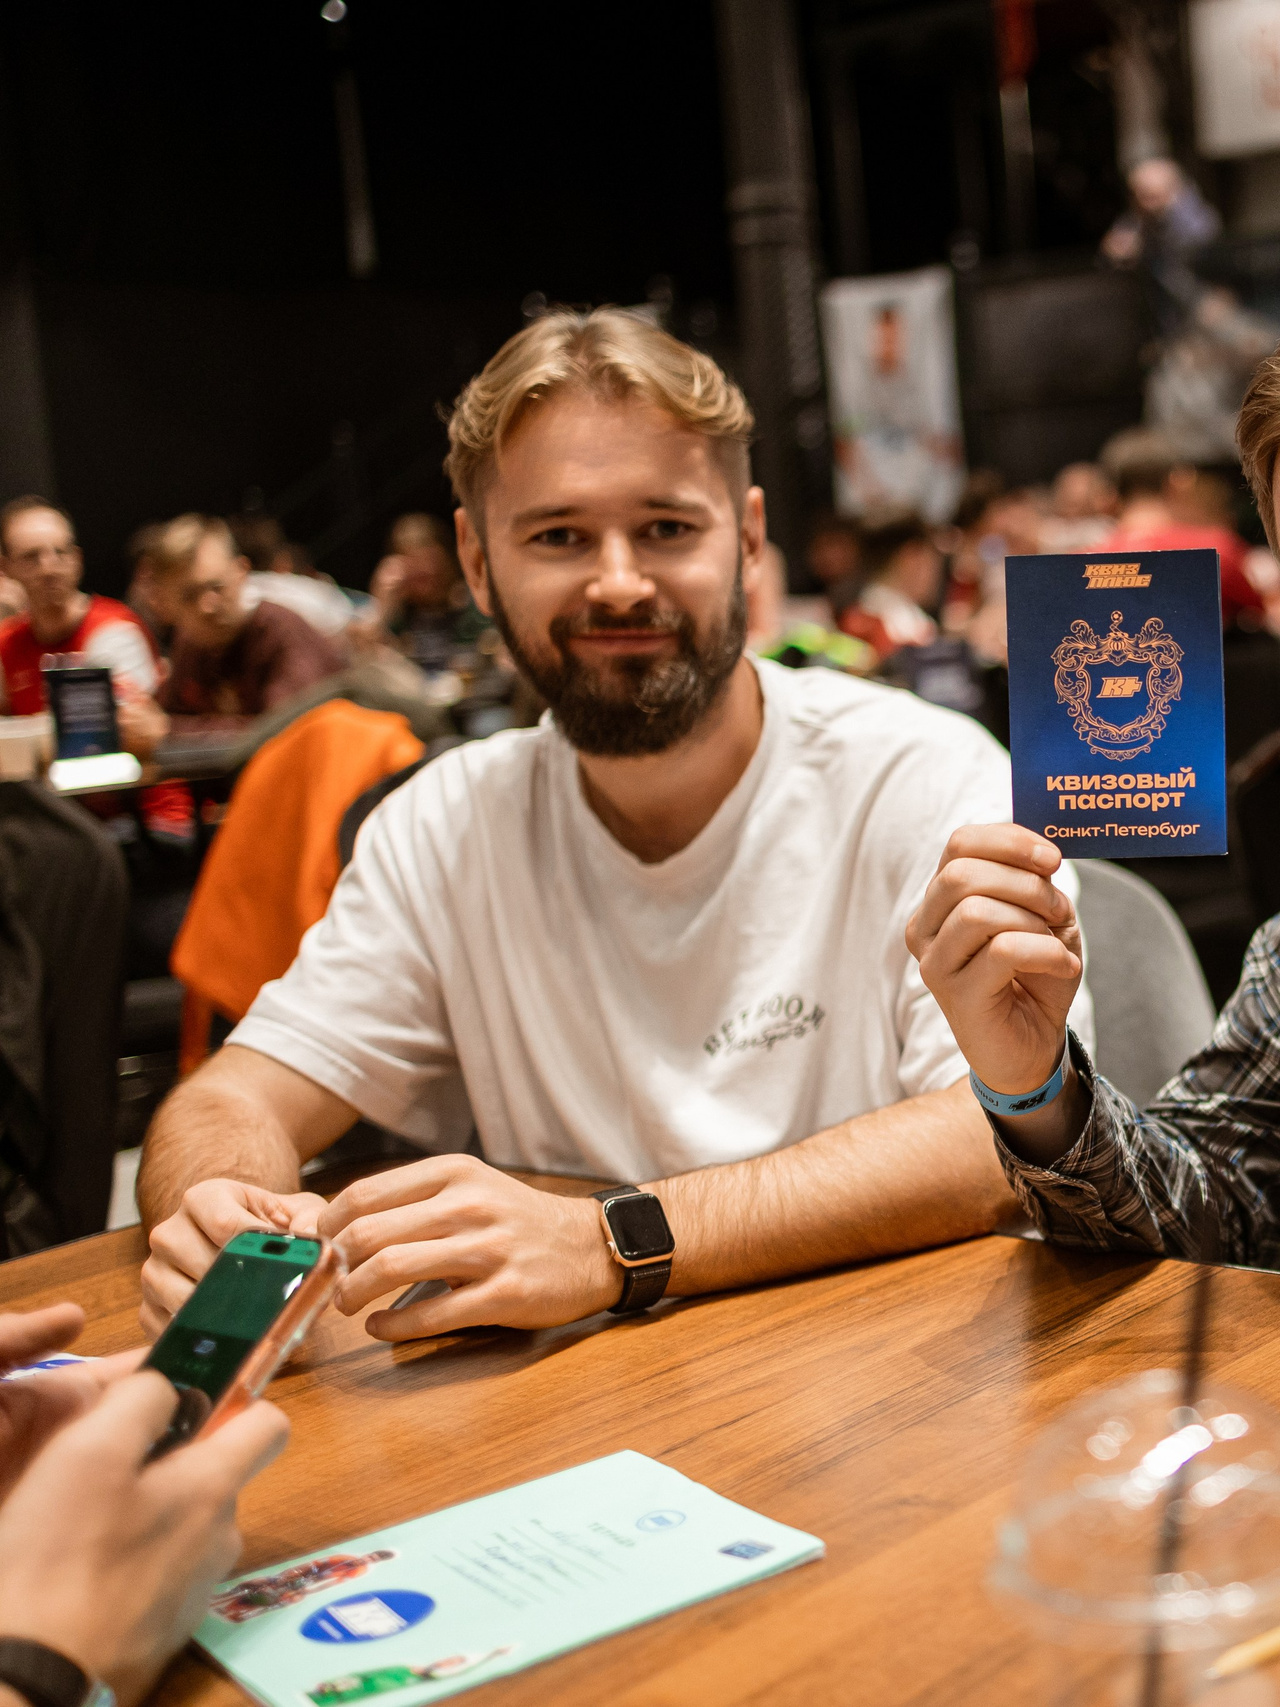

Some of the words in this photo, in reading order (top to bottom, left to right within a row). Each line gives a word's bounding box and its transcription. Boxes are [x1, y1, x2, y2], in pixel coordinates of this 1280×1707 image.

[1082, 563, 1141, 577] КВИЗ
[1085, 574, 1152, 589] ПЛЮС
[1058, 792, 1186, 812] паспорт
[1044, 822, 1201, 838] Санкт-Петербург
